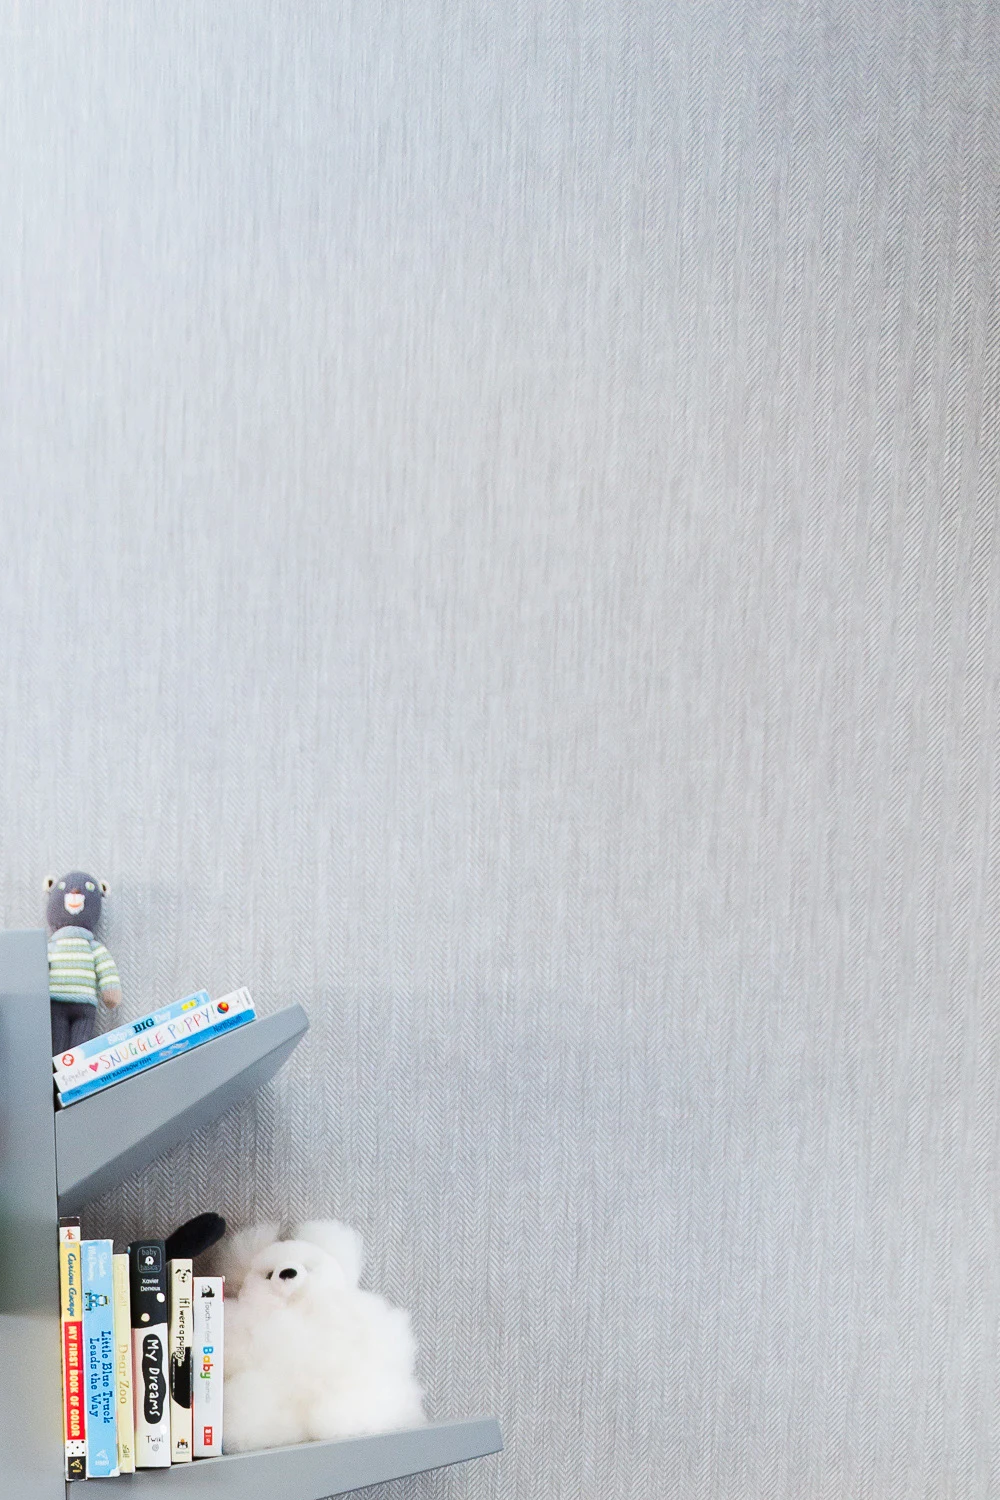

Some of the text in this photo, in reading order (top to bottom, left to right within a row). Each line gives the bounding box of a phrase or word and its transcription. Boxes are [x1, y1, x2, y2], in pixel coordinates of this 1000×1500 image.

[99, 1004, 218, 1070] SNUGGLE PUPPY!
[132, 1017, 155, 1034] BIG
[112, 1062, 139, 1078] RAINBOW
[67, 1252, 77, 1286] Curious
[66, 1287, 78, 1317] George
[204, 1301, 212, 1320] Touch
[68, 1325, 81, 1437] MY FIRST BOOK OF COLOR
[88, 1337, 102, 1418] Leads the Way
[101, 1330, 114, 1424] Little Blue Truck
[119, 1344, 130, 1405] Dear Zoo
[145, 1339, 161, 1417] My Dreams
[200, 1345, 214, 1379] Baby
